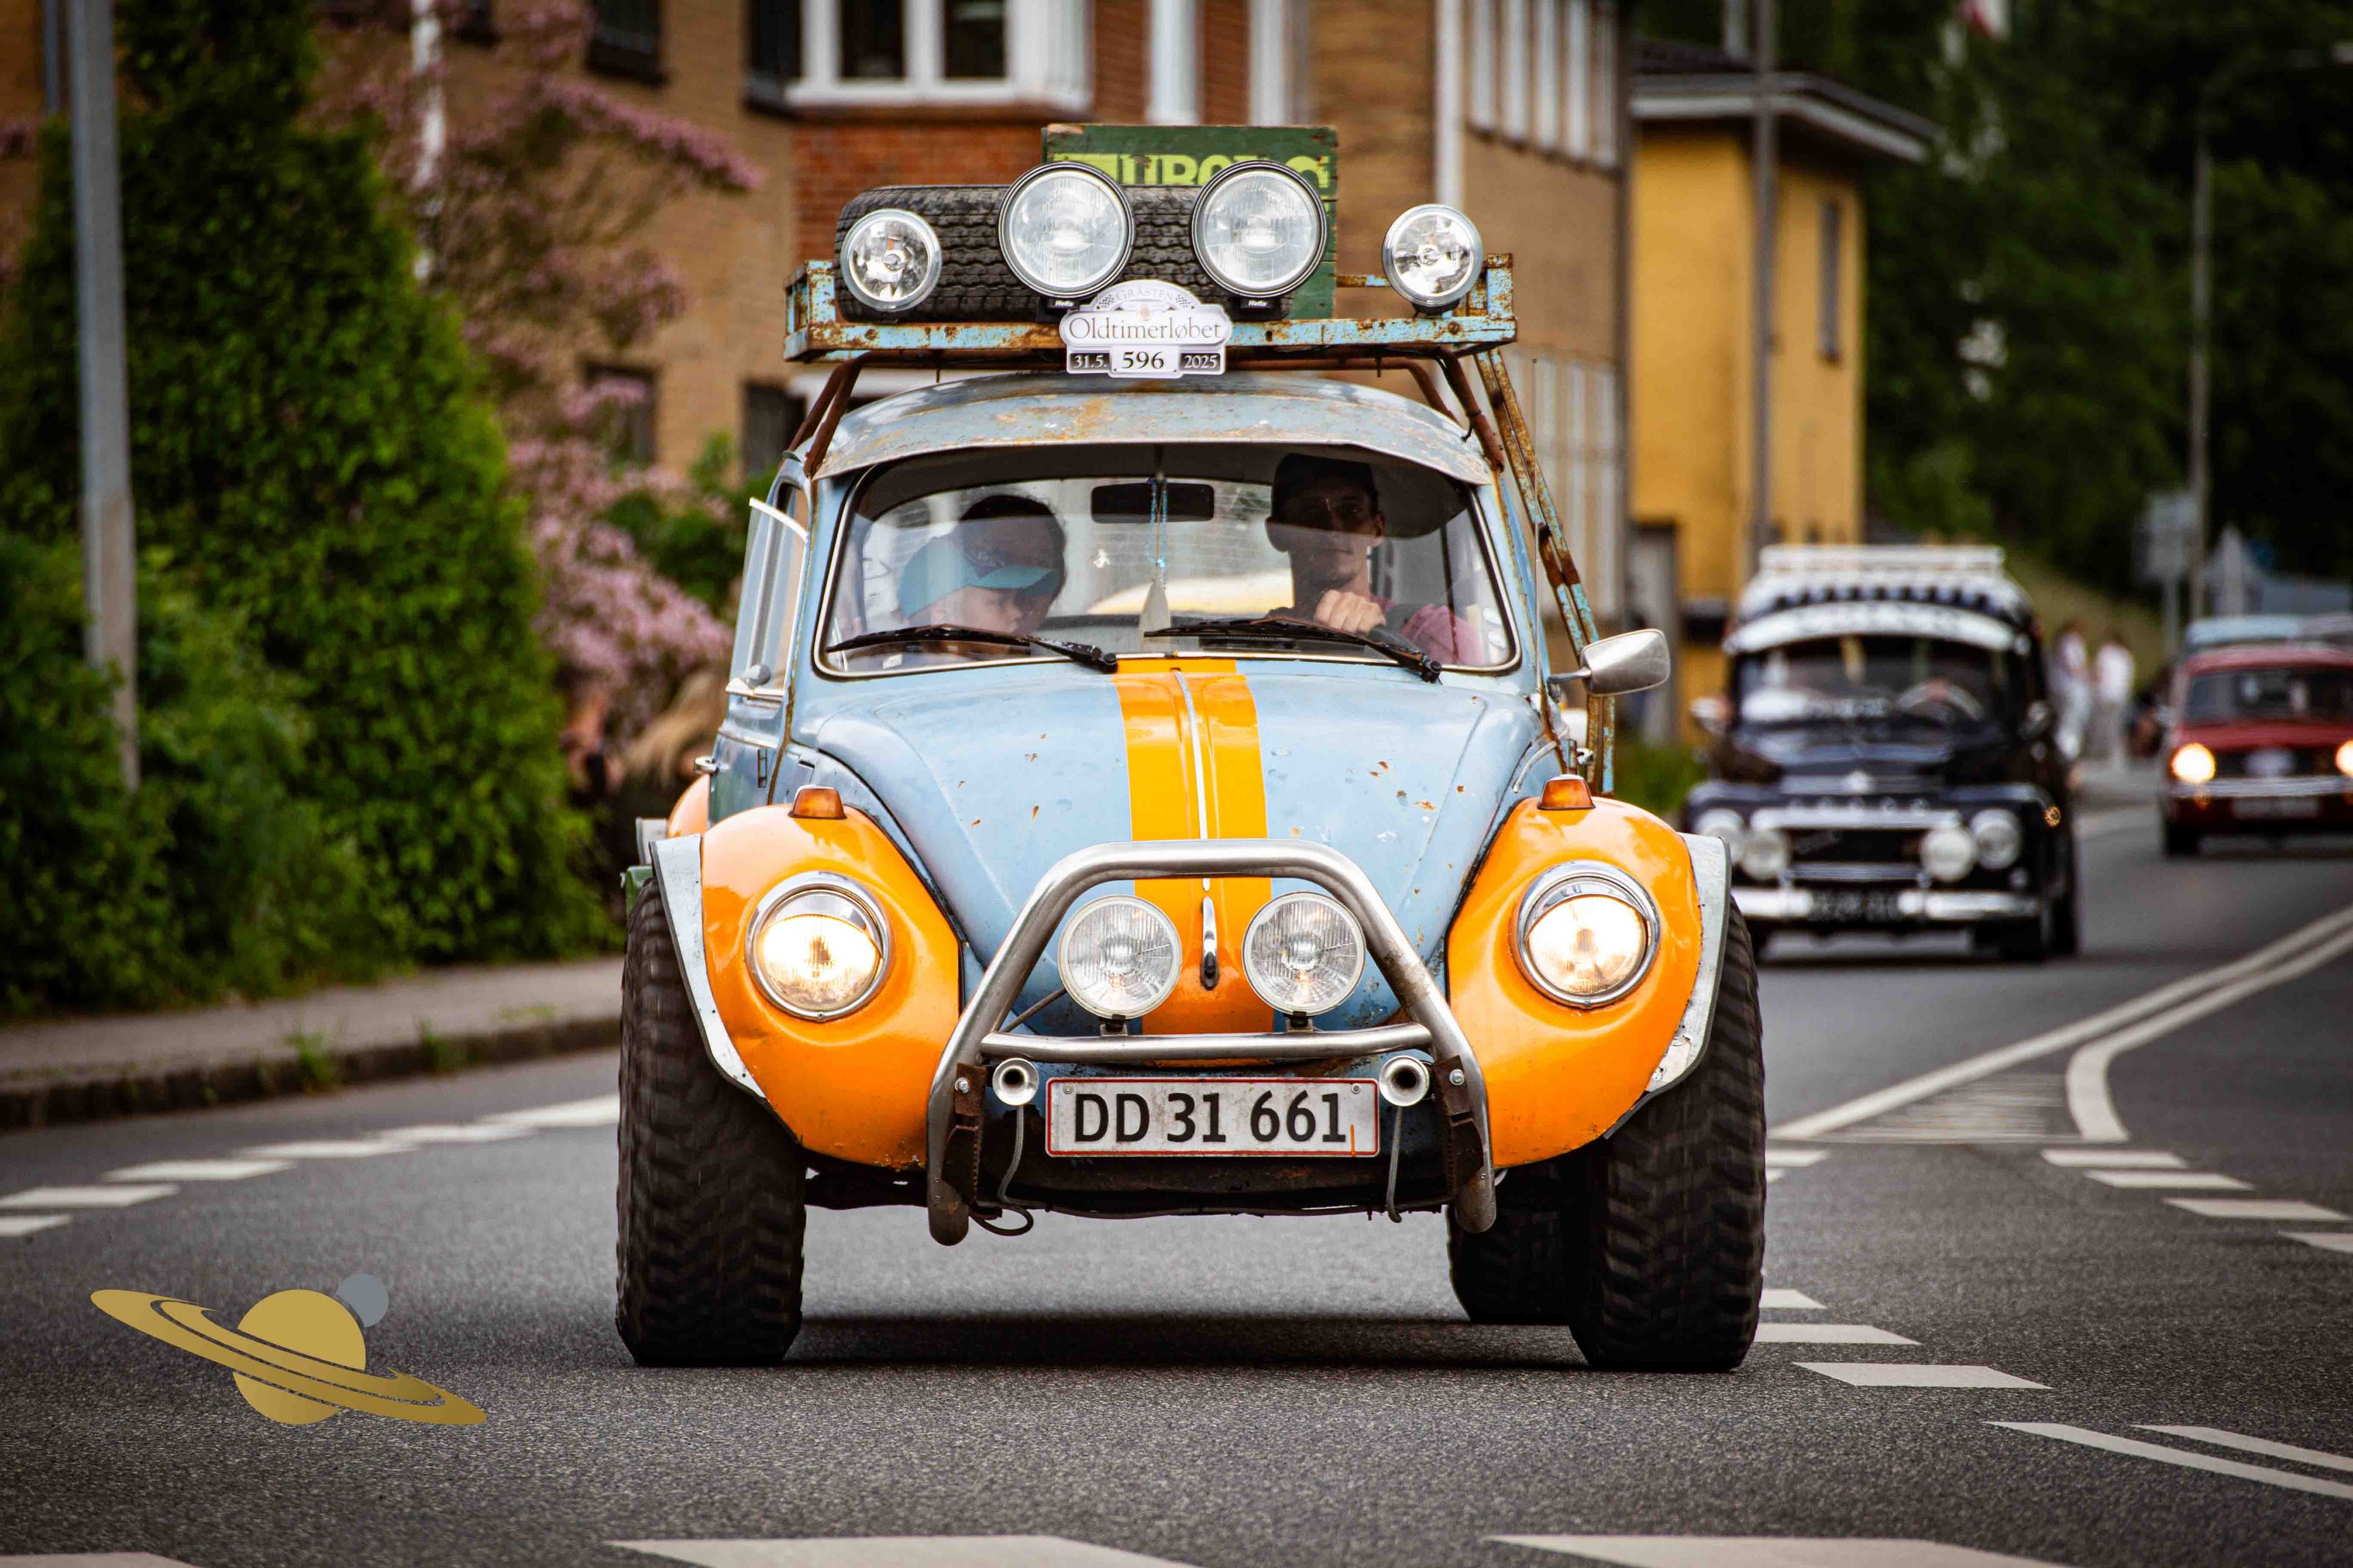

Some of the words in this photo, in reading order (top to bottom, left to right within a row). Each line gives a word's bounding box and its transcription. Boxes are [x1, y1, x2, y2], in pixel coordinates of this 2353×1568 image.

[1068, 317, 1221, 340] Oldtimerløbet
[1074, 355, 1107, 368] 31.5.
[1121, 351, 1165, 370] 596
[1184, 355, 1218, 369] 2025
[1074, 1093, 1151, 1142] DD
[1166, 1092, 1227, 1142] 31
[1250, 1090, 1346, 1143] 661
